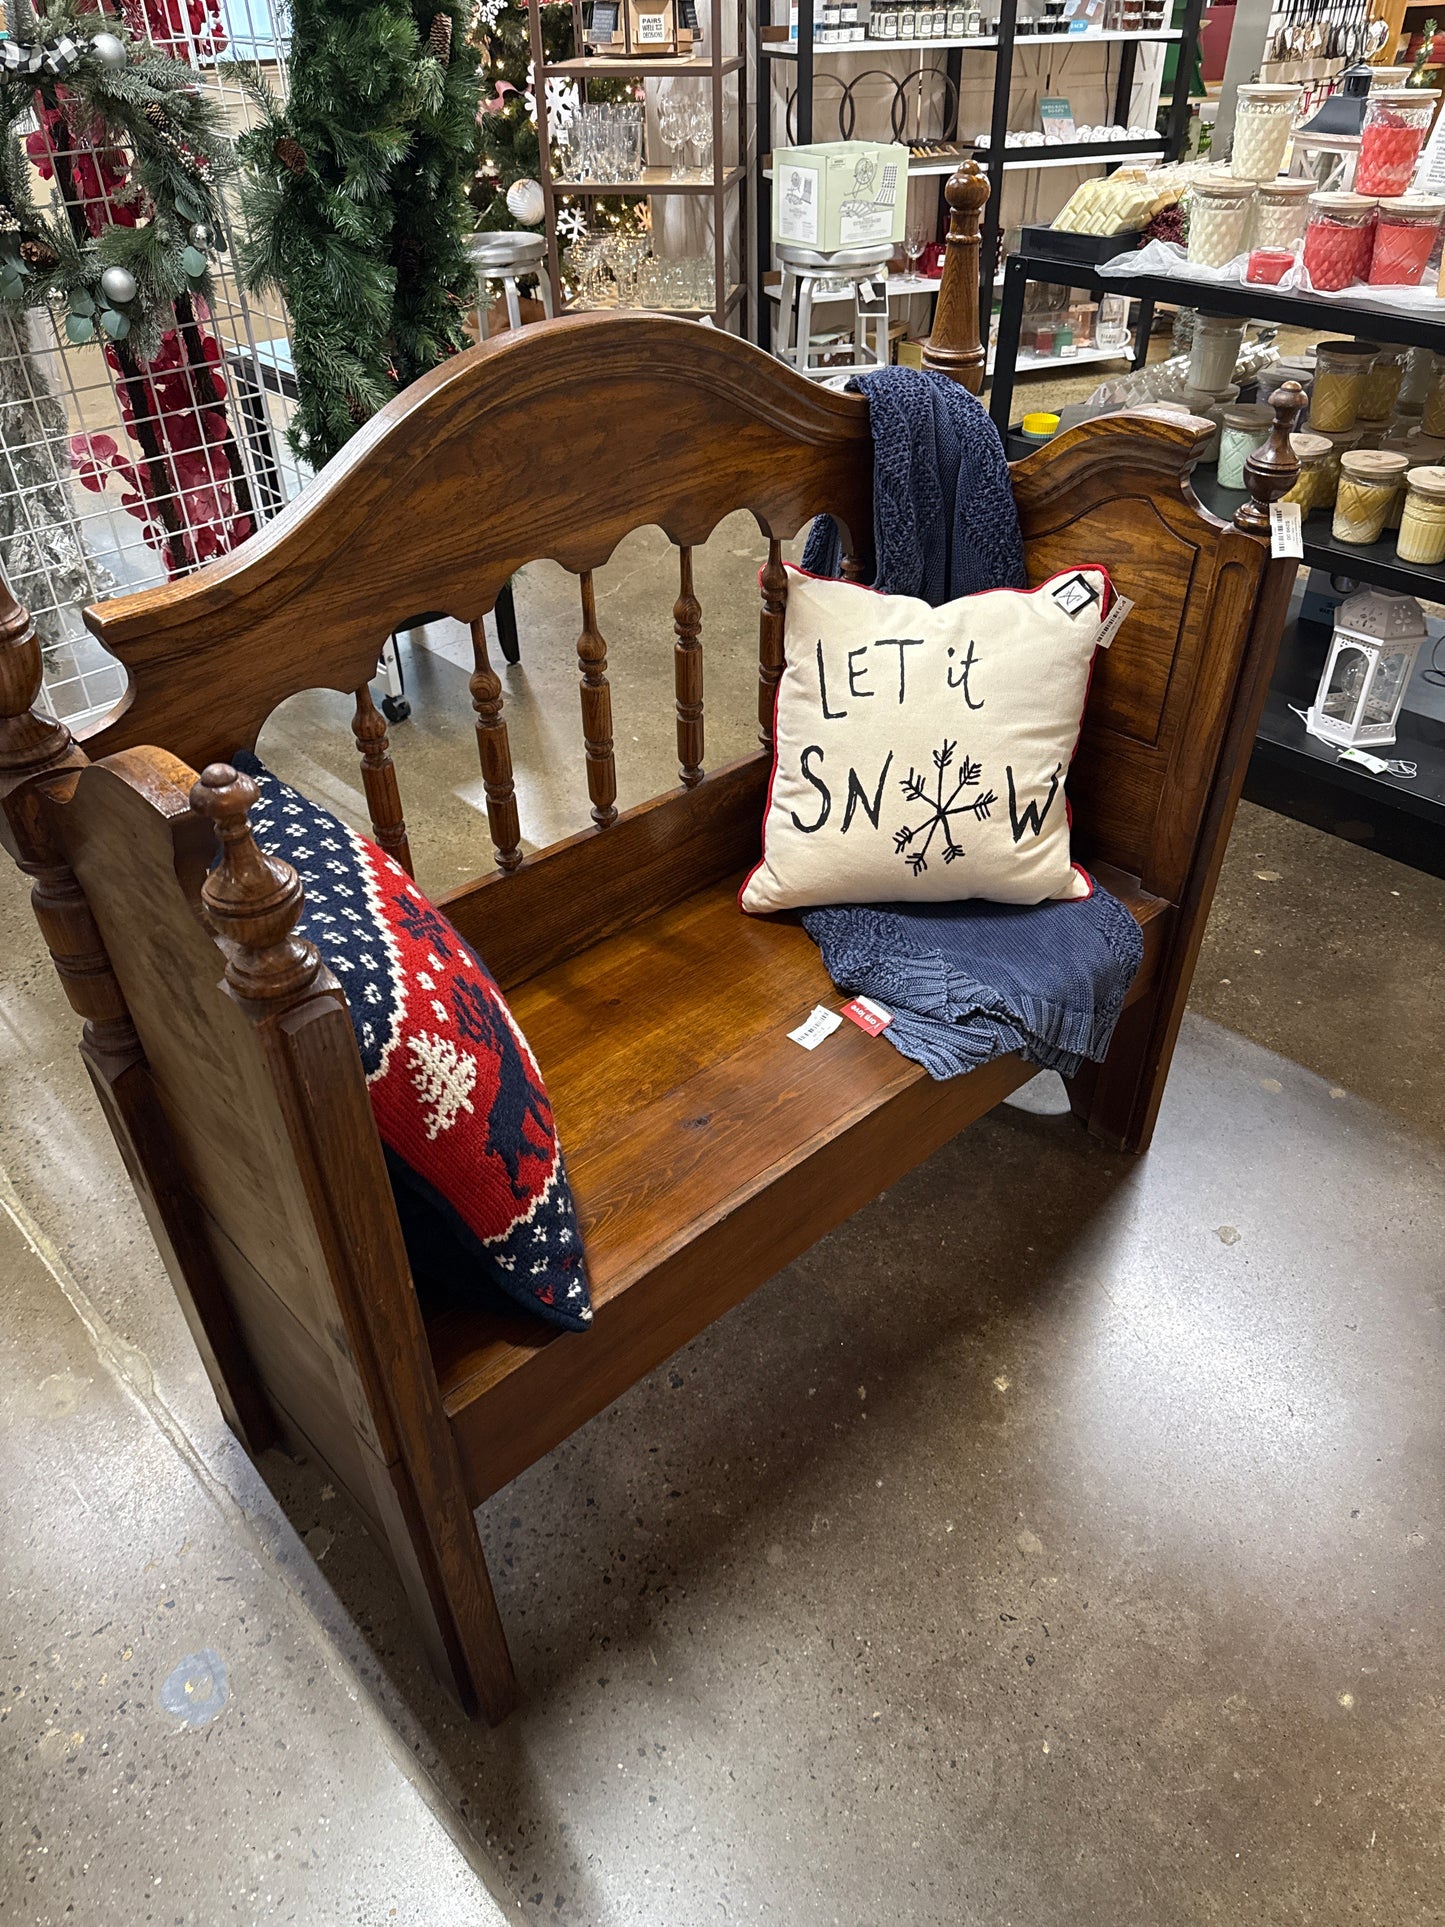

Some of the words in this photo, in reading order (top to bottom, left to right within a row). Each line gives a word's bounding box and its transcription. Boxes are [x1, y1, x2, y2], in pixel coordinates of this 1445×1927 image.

[816, 638, 924, 719] LET
[946, 640, 984, 709] it
[791, 739, 1062, 877] SNW
[851, 1004, 866, 1018] love
